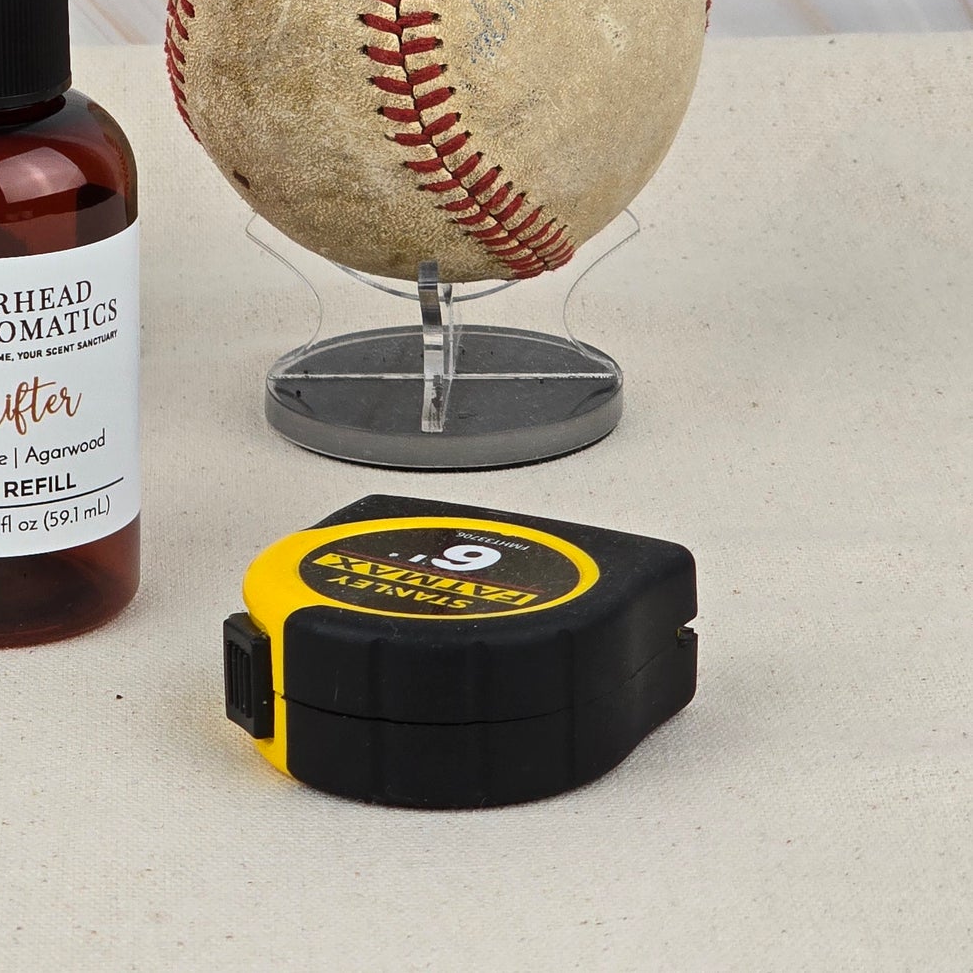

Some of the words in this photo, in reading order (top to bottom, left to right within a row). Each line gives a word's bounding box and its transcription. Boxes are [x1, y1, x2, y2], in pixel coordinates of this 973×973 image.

[17, 350, 42, 360] YOUR
[46, 344, 74, 356] SCENT
[77, 330, 117, 350] SANCTUARY
[25, 428, 105, 465] Agarwood
[4, 473, 76, 498] REFILL
[1, 515, 11, 533] fl
[18, 520, 38, 531] oz
[44, 507, 78, 531] (59.1
[82, 493, 110, 519] mL)
[457, 532, 530, 550] FMHT33706
[326, 576, 474, 608] STANLEY
[332, 554, 529, 604] FATMAX
